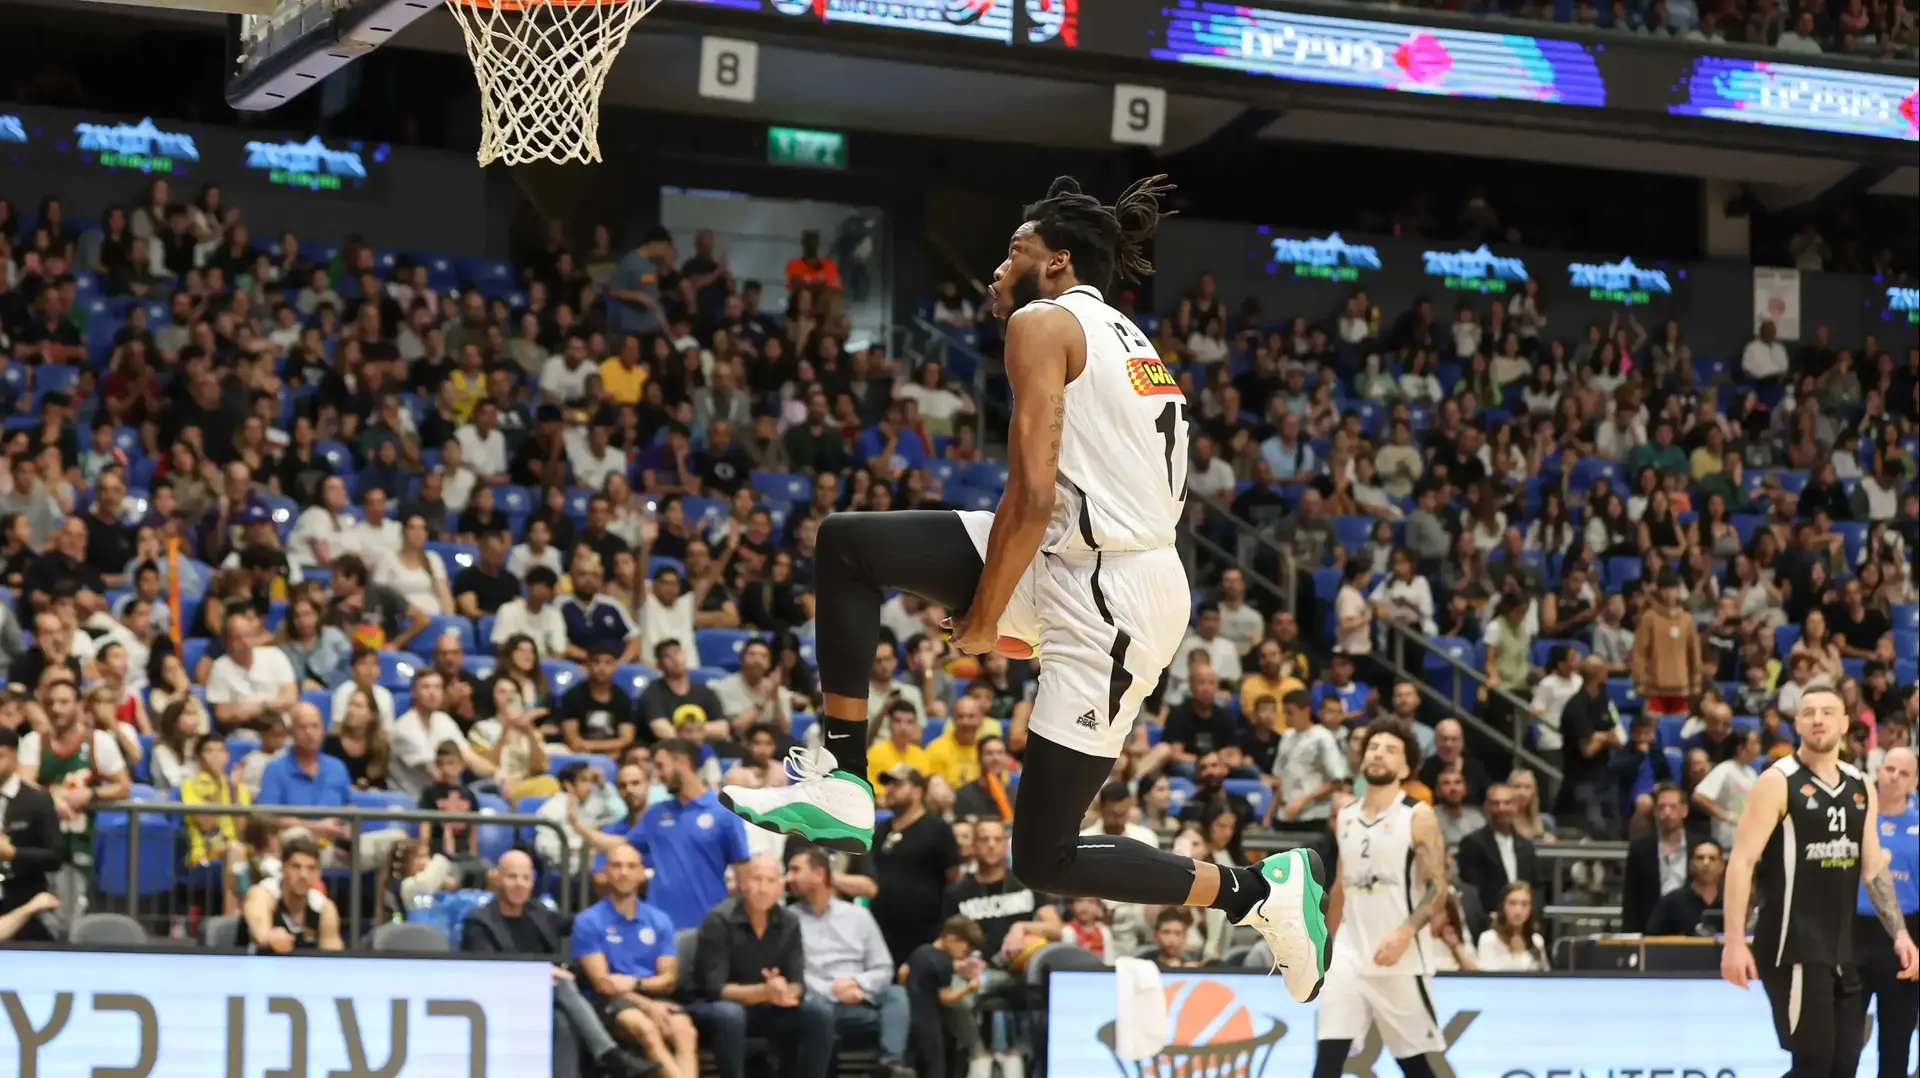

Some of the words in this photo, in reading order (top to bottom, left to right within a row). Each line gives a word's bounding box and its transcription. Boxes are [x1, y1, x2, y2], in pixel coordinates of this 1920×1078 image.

[716, 51, 739, 86] 8
[1126, 97, 1150, 132] 9
[1826, 805, 1847, 833] 21
[1360, 837, 1370, 859] 2
